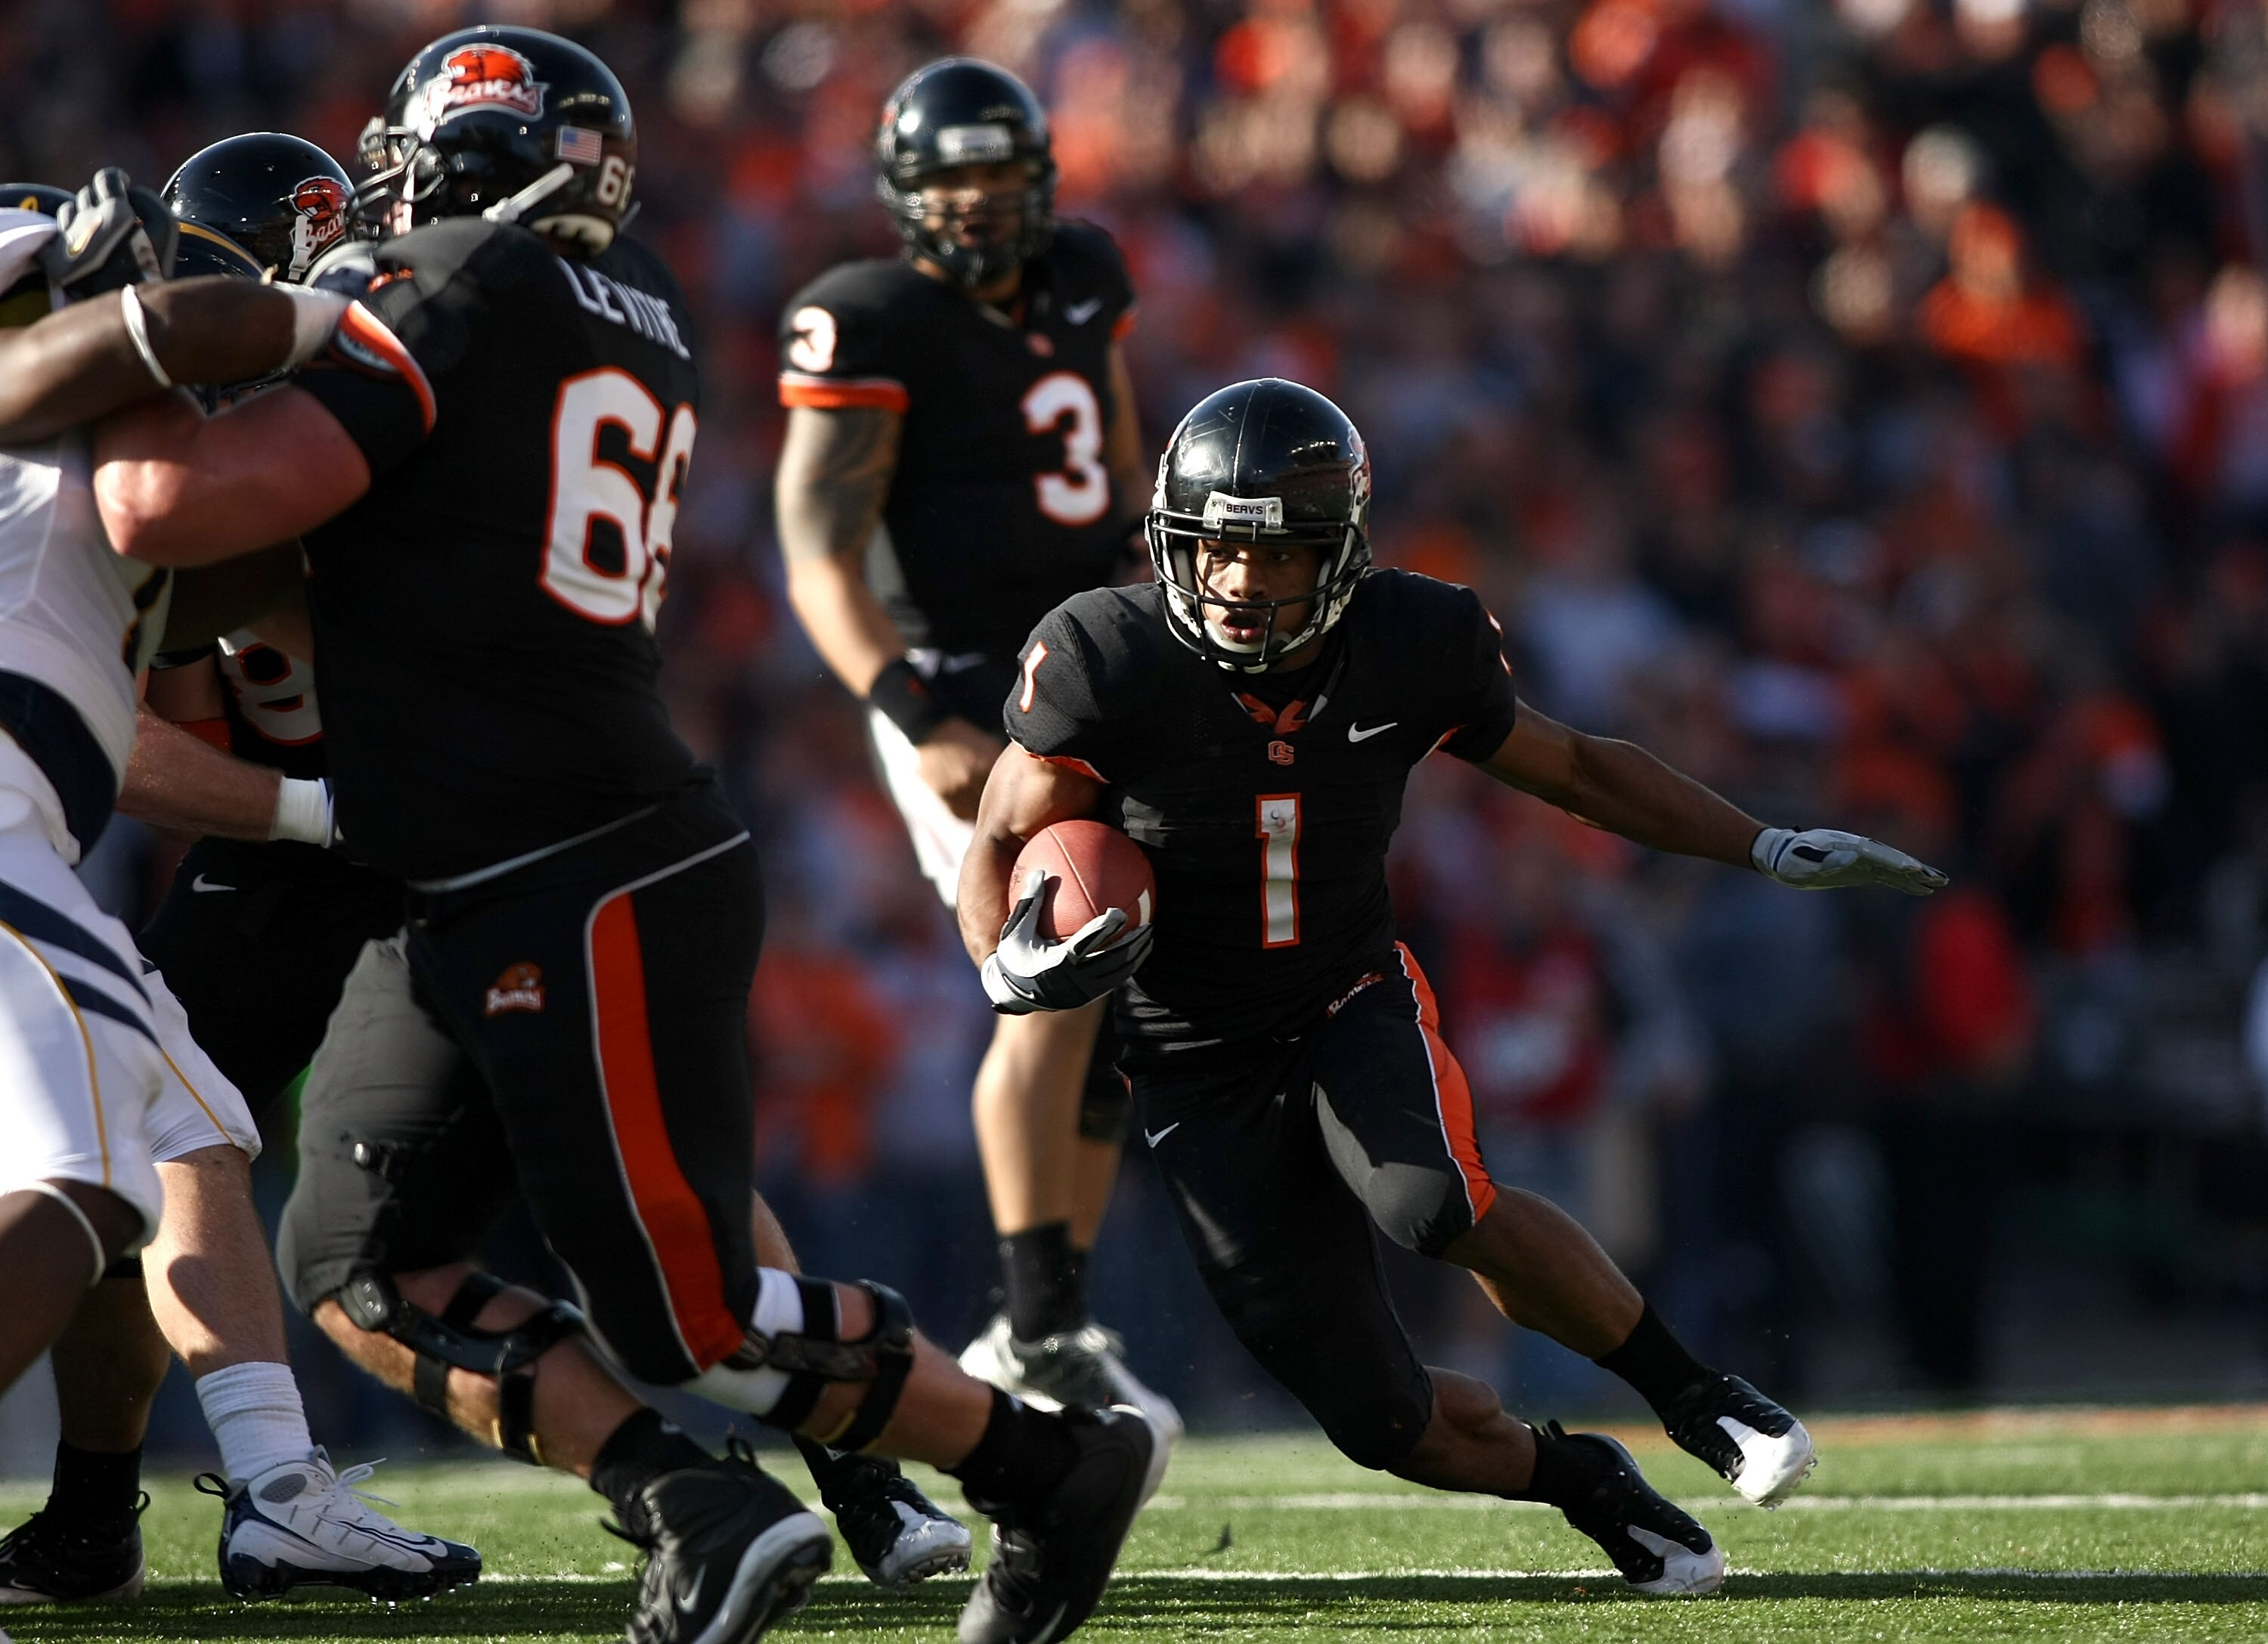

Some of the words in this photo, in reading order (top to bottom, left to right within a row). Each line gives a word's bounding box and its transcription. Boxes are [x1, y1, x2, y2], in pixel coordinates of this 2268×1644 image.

[789, 306, 838, 373] 3
[1020, 370, 1111, 526] 3
[1226, 504, 1263, 514] BEAVS
[1019, 641, 1049, 714] 1
[1255, 792, 1301, 949] 1
